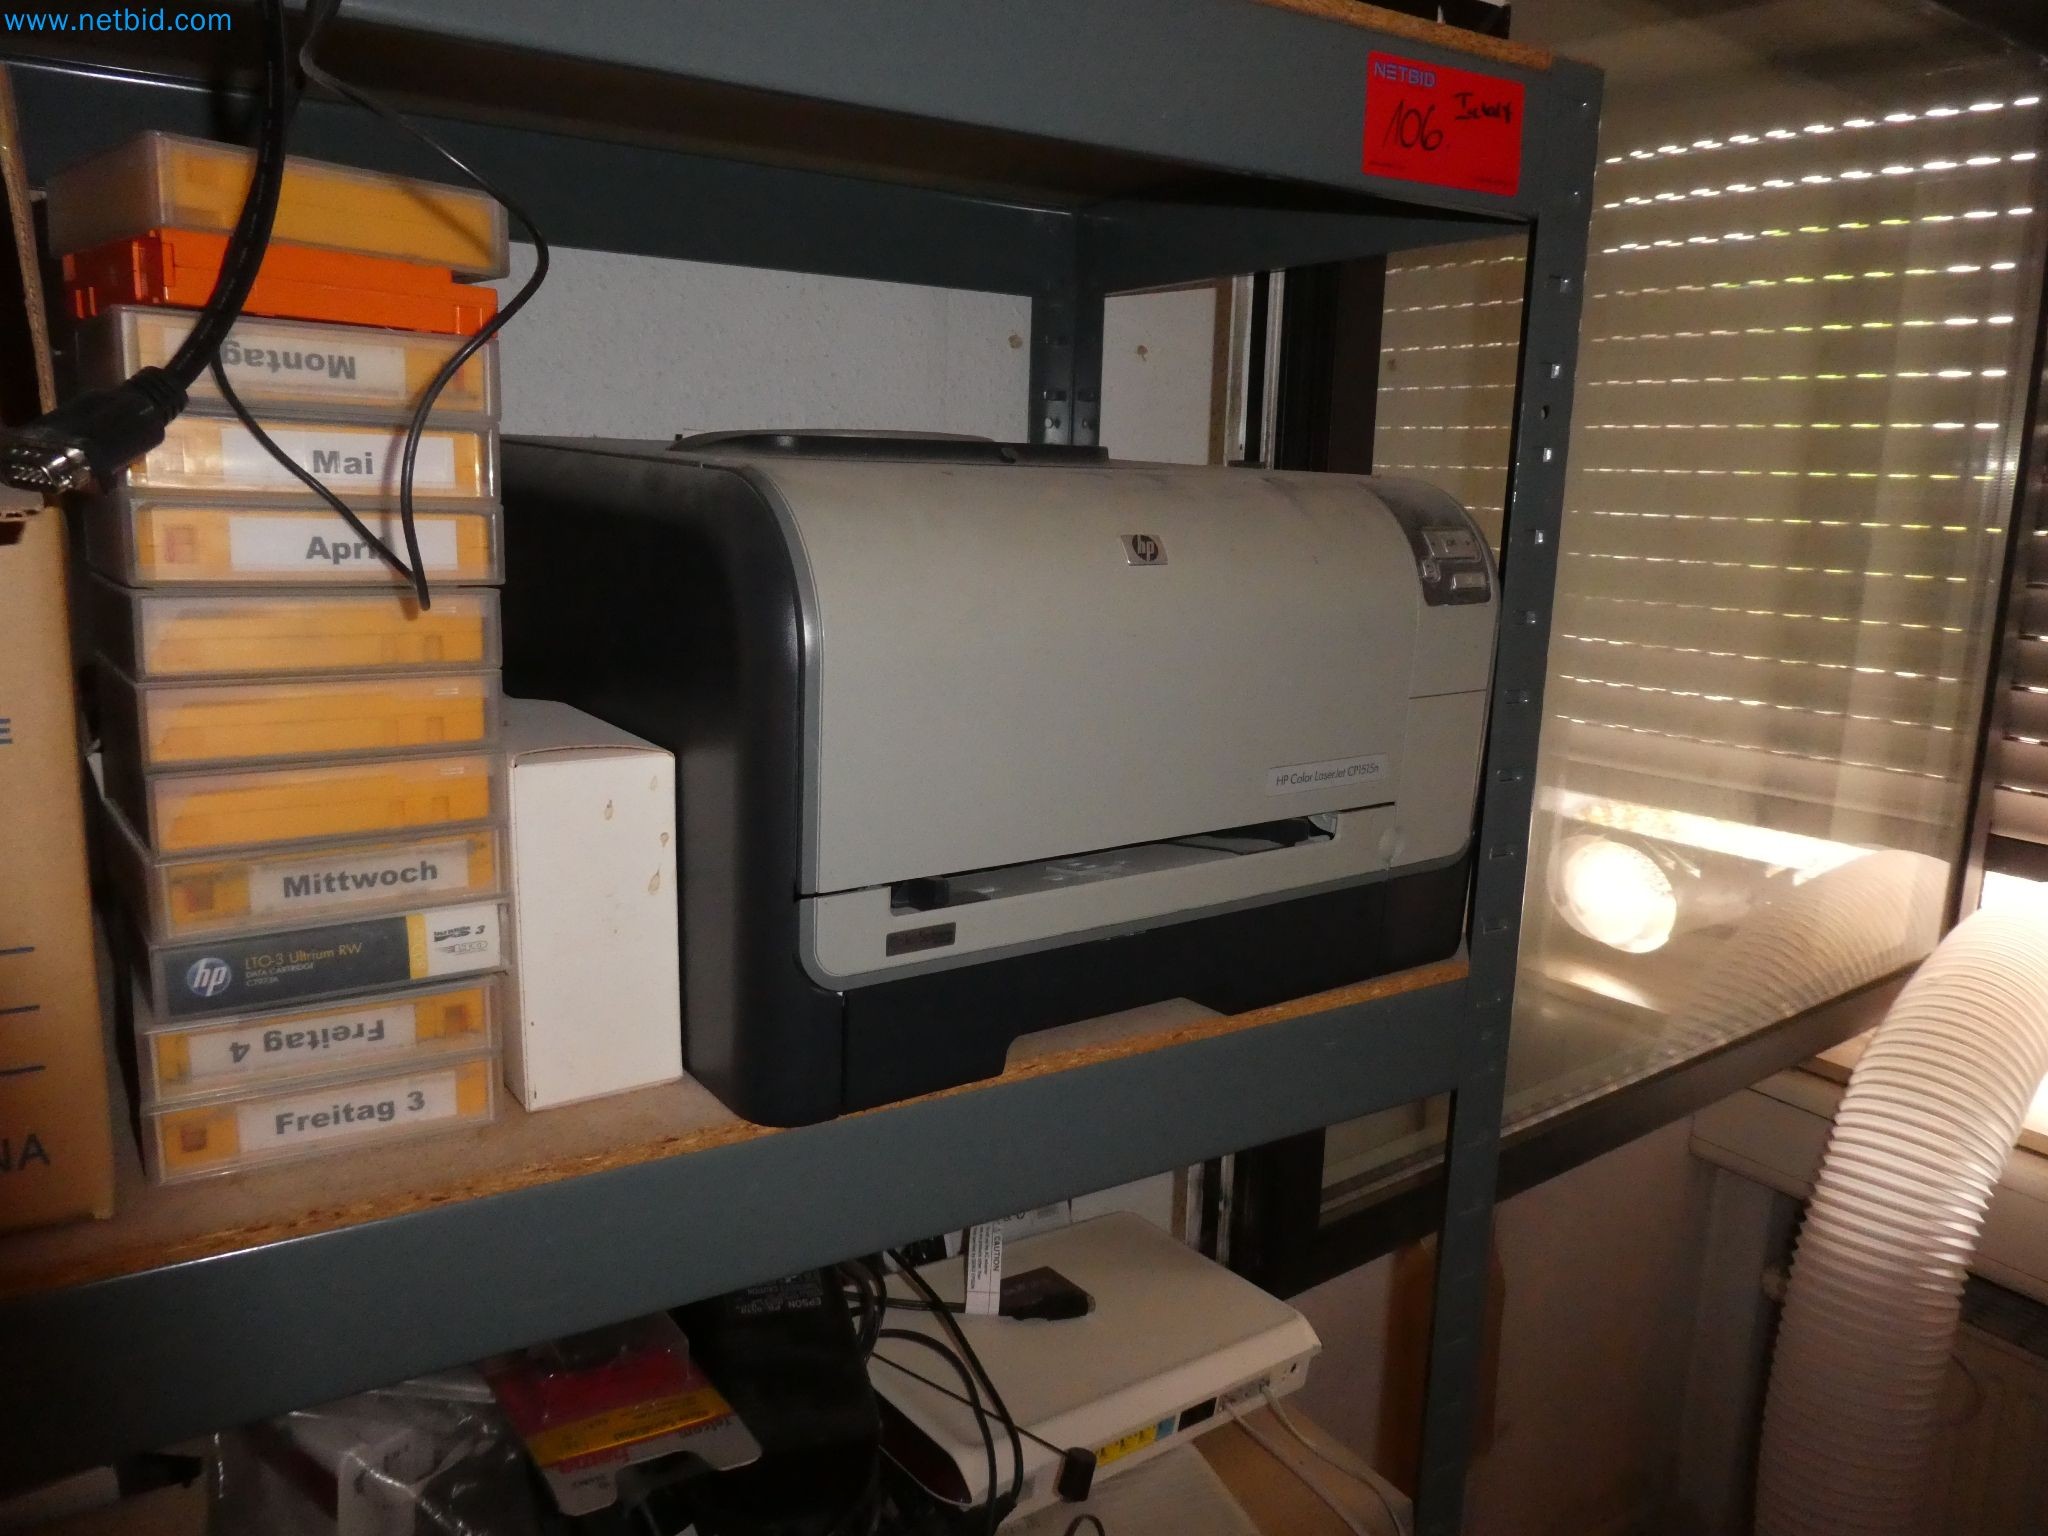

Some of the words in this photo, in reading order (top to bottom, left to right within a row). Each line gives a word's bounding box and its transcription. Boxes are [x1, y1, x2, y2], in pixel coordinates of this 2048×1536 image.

[1374, 61, 1436, 88] NETBID
[1382, 99, 1444, 151] 106
[221, 340, 357, 380] Montag
[312, 450, 374, 475] Mai
[1136, 535, 1156, 561] hp
[1275, 774, 1289, 786] HP
[1290, 772, 1312, 785] Color
[1314, 768, 1345, 782] LaserJet
[283, 861, 438, 898] Mittwoch
[475, 924, 486, 935] 3
[244, 952, 285, 970] LTO-3
[289, 948, 335, 963] Ultrium
[338, 943, 363, 955] RW
[191, 958, 228, 997] hp
[244, 969, 268, 978] DATA
[263, 1019, 385, 1052] Freitag
[229, 1042, 251, 1064] 4
[275, 1100, 396, 1135] Freitag
[407, 1090, 426, 1111] 3
[993, 1235, 1002, 1272] CAUTION
[787, 1296, 823, 1309] EPSON
